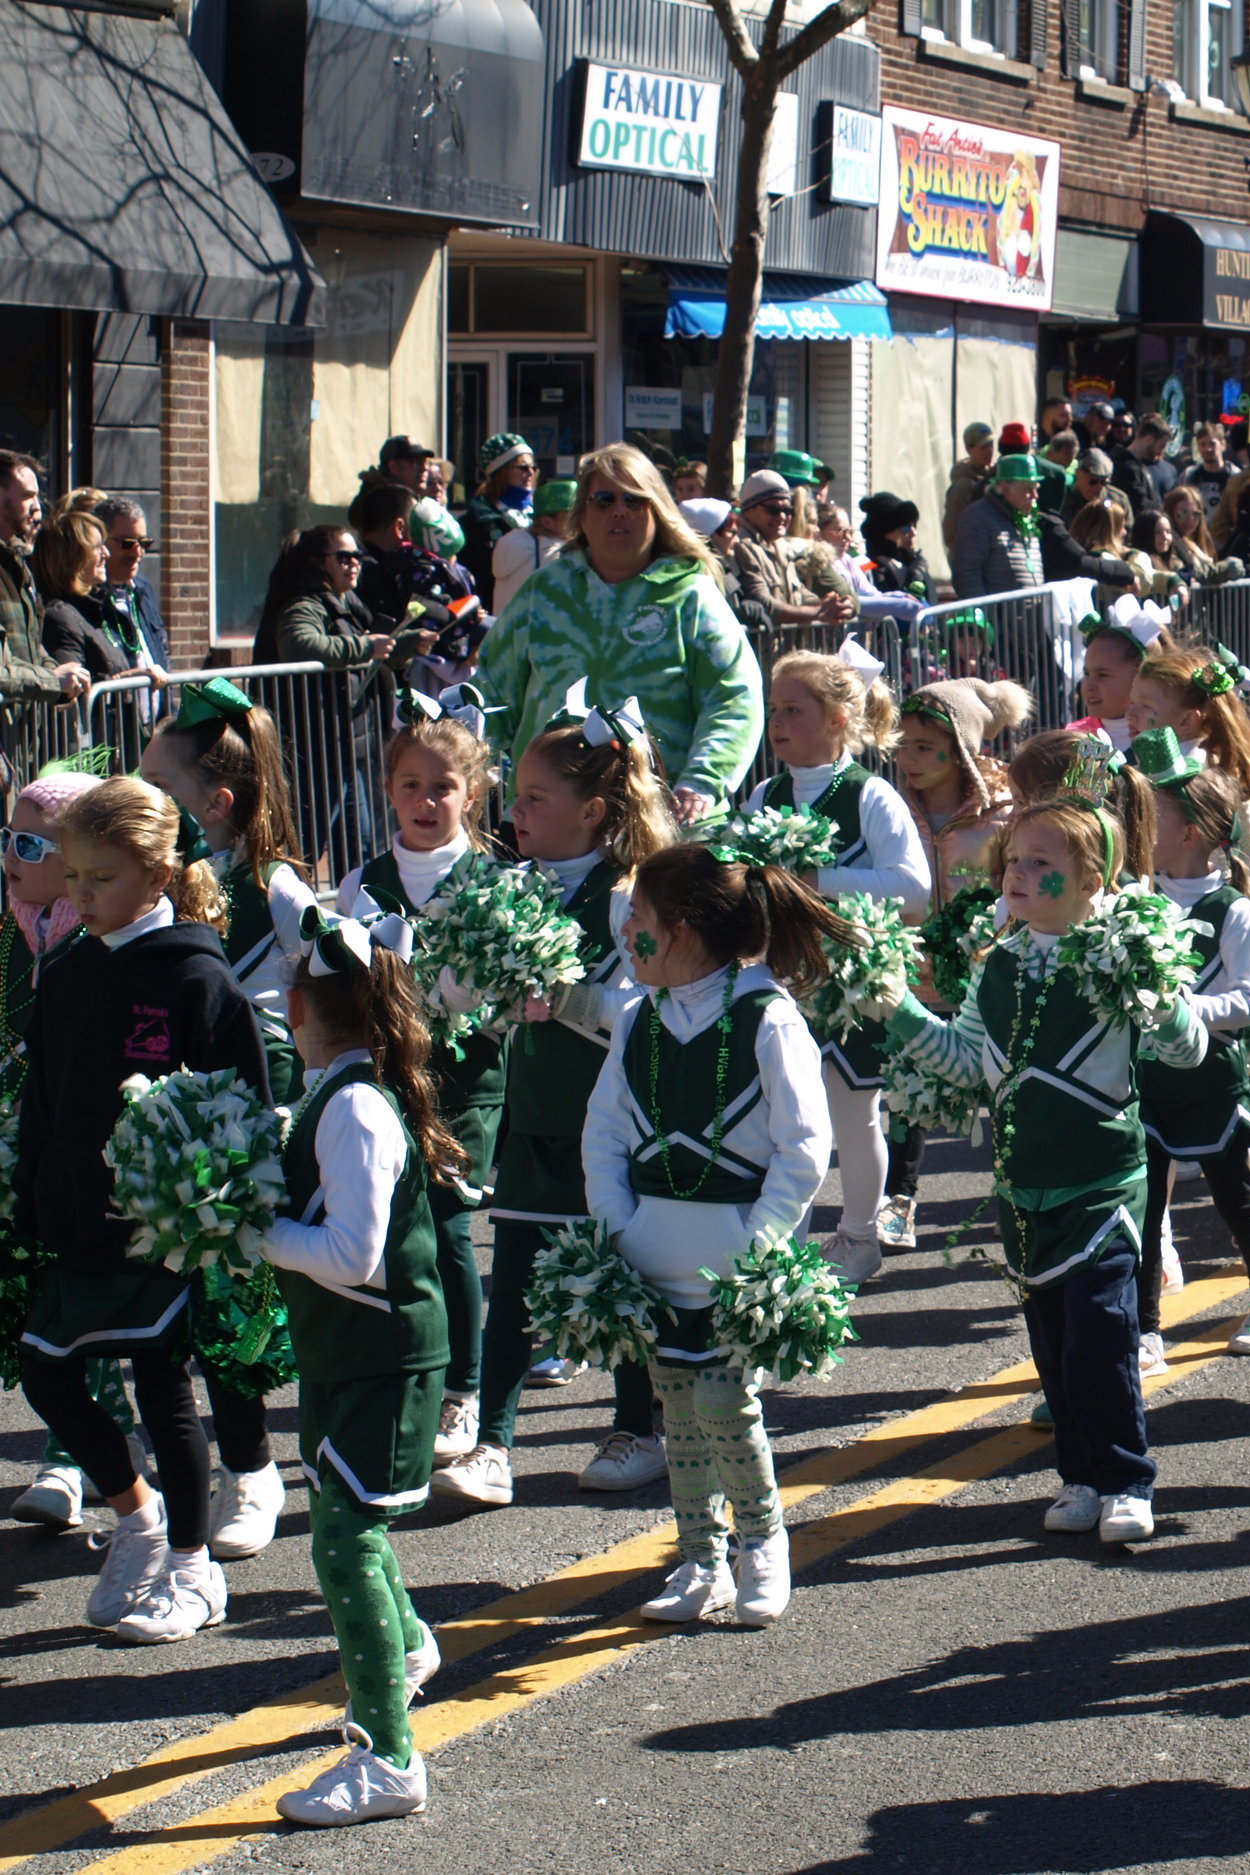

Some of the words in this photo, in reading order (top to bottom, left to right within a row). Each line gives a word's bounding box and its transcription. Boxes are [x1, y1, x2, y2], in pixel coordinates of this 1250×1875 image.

[603, 70, 704, 122] FAMILY
[260, 157, 284, 177] 72
[588, 118, 709, 173] OPTICAL
[899, 135, 1007, 213] BURRITO
[907, 192, 989, 255] SHACK
